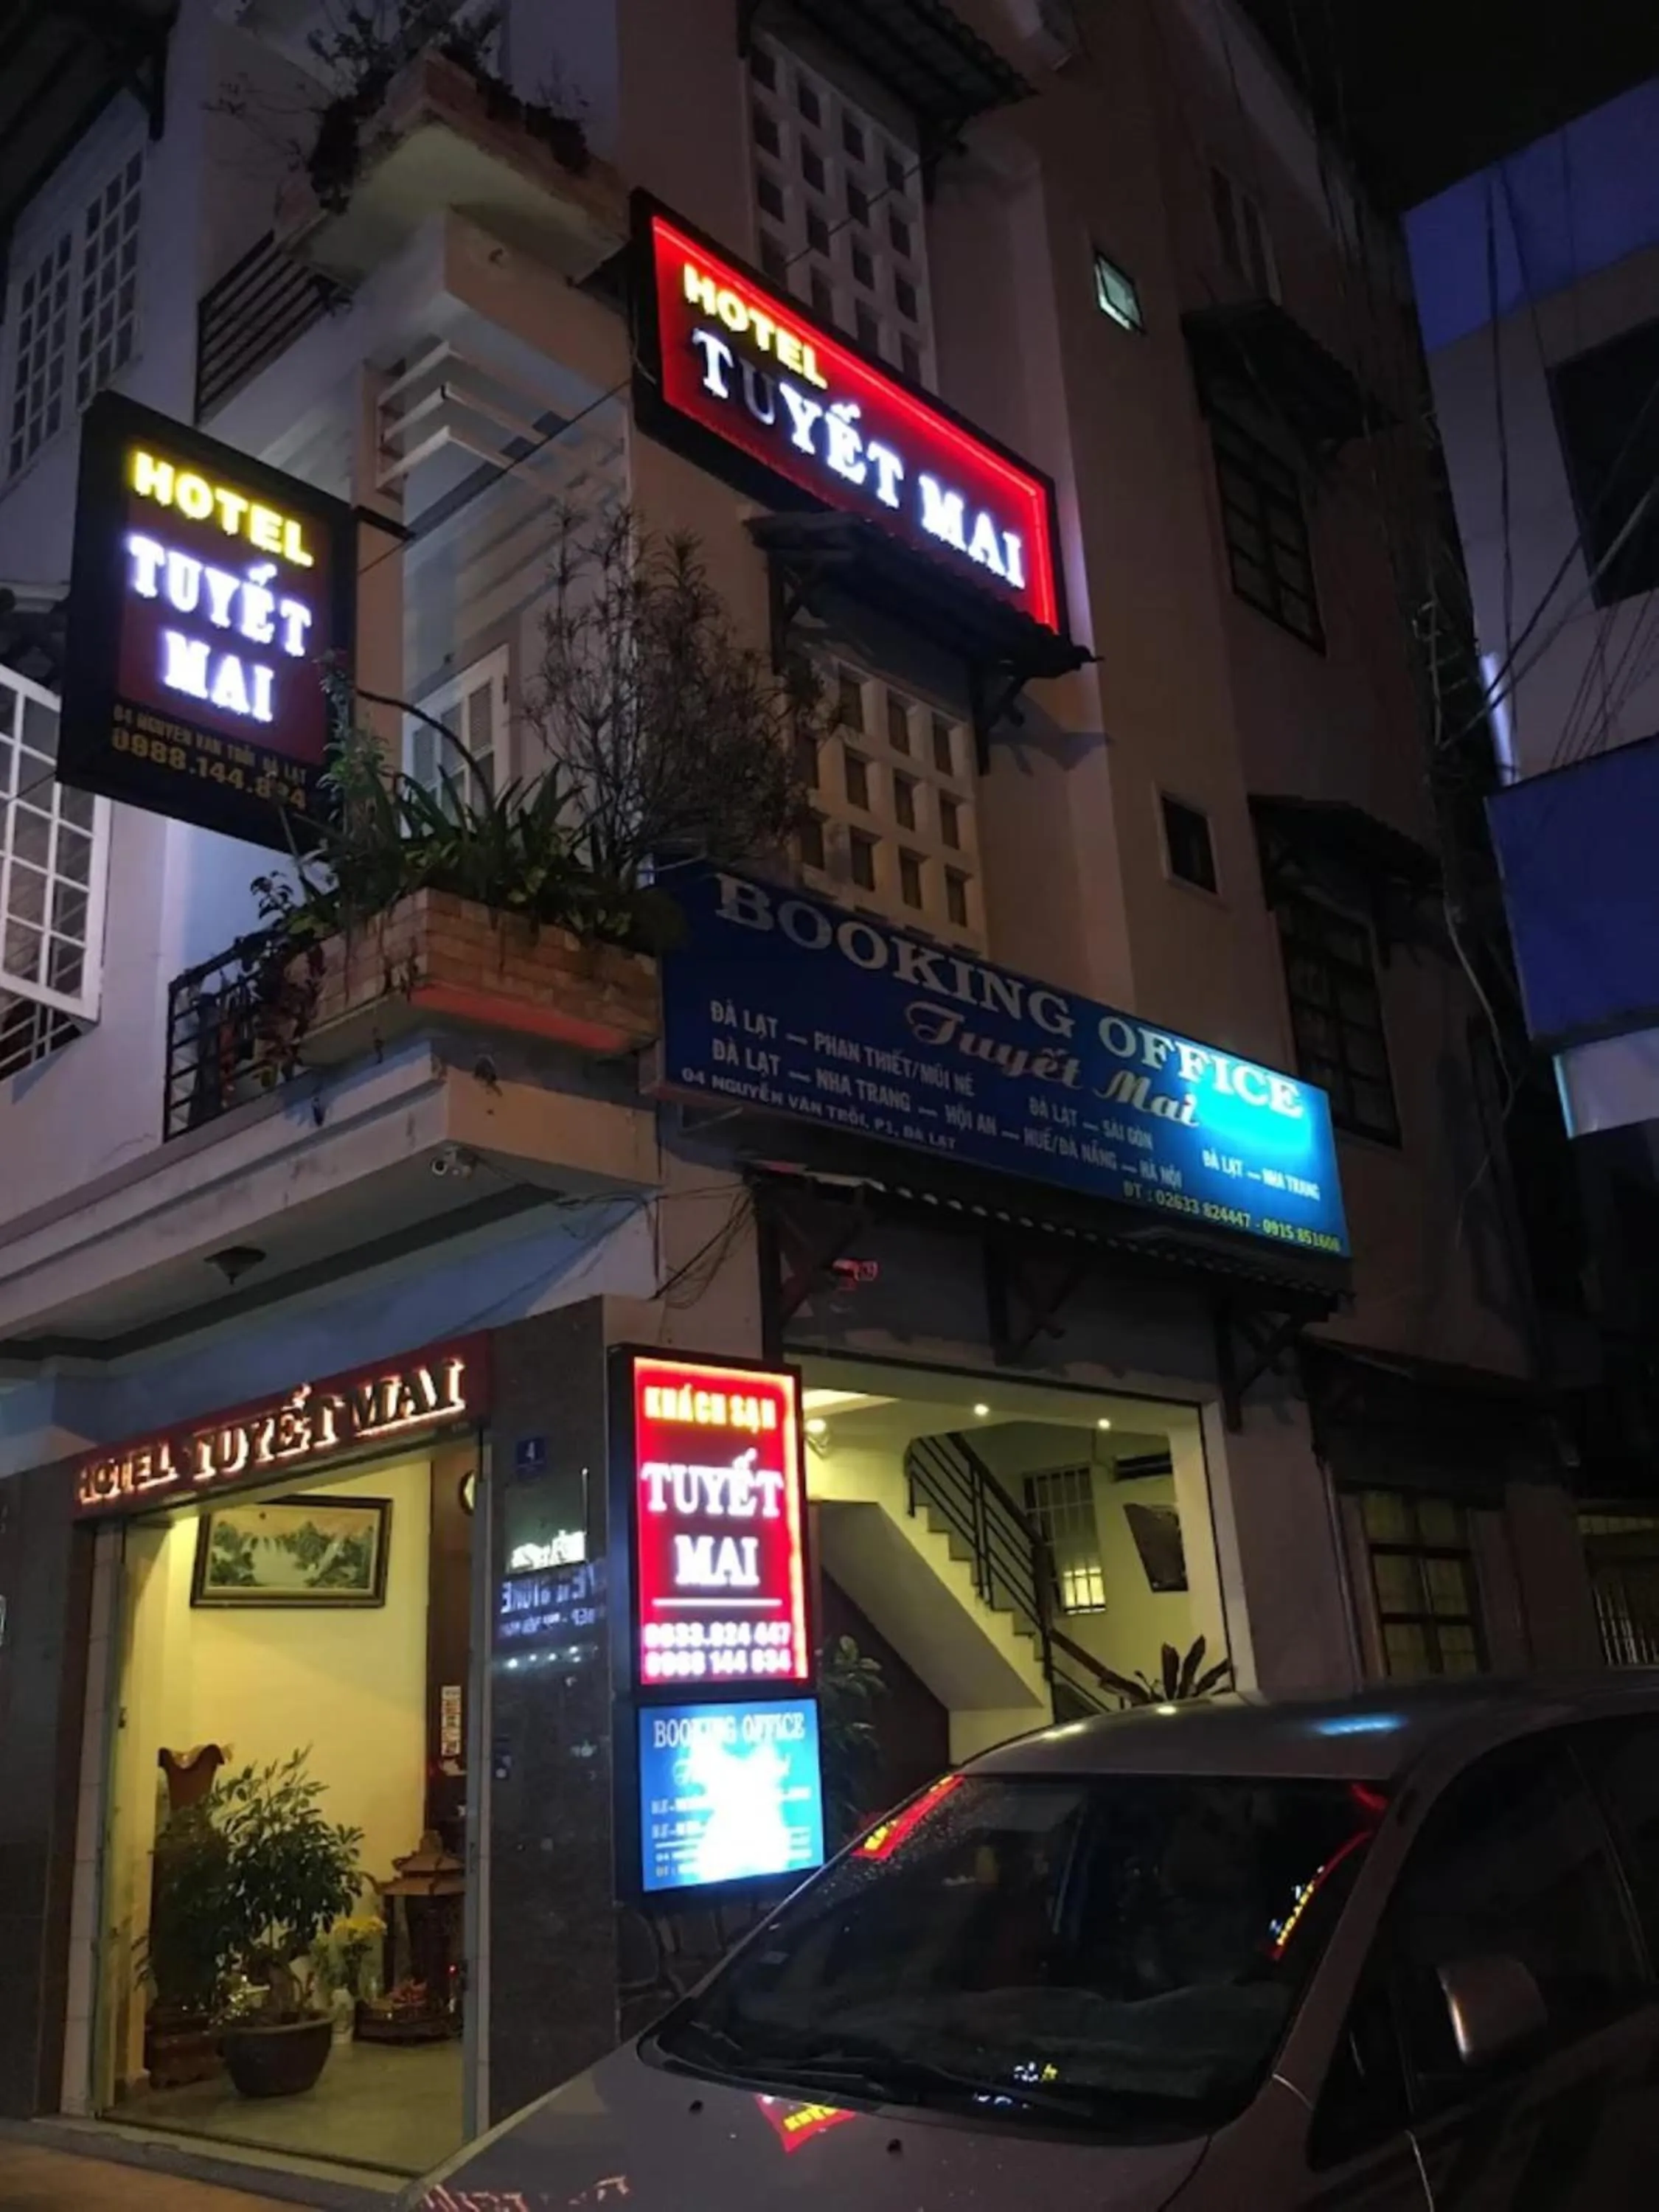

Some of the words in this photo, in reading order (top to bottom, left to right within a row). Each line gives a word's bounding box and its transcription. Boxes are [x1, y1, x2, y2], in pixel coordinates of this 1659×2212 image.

[684, 262, 828, 390] HOTEL
[692, 328, 905, 509] TUYẾT
[919, 473, 1026, 590] MAI
[133, 450, 315, 568] HOTEL
[126, 534, 313, 658] TUYẾT
[163, 629, 274, 723] MAI
[710, 997, 737, 1029] ĐÀ
[743, 1009, 779, 1041] LẠT
[814, 1031, 862, 1064] PHAN
[714, 873, 1076, 1039] BOOKING
[1099, 1016, 1307, 1119] OFFICE
[712, 1035, 738, 1065] ĐÀ
[745, 1048, 782, 1081] LẠT
[815, 1067, 852, 1098] NHA
[857, 1079, 911, 1113] TRANG
[945, 1103, 973, 1132] HỘI
[975, 1113, 998, 1137] AN
[905, 1001, 1084, 1093] Tuyết
[1092, 1069, 1201, 1128] Mai
[1051, 1103, 1078, 1129] LẠT
[1202, 1147, 1220, 1172] ĐÀ
[1220, 1155, 1243, 1179] LẠT
[351, 1357, 466, 1439] MAI
[641, 1447, 784, 1519] TUYẾT
[674, 1534, 760, 1587] MAI
